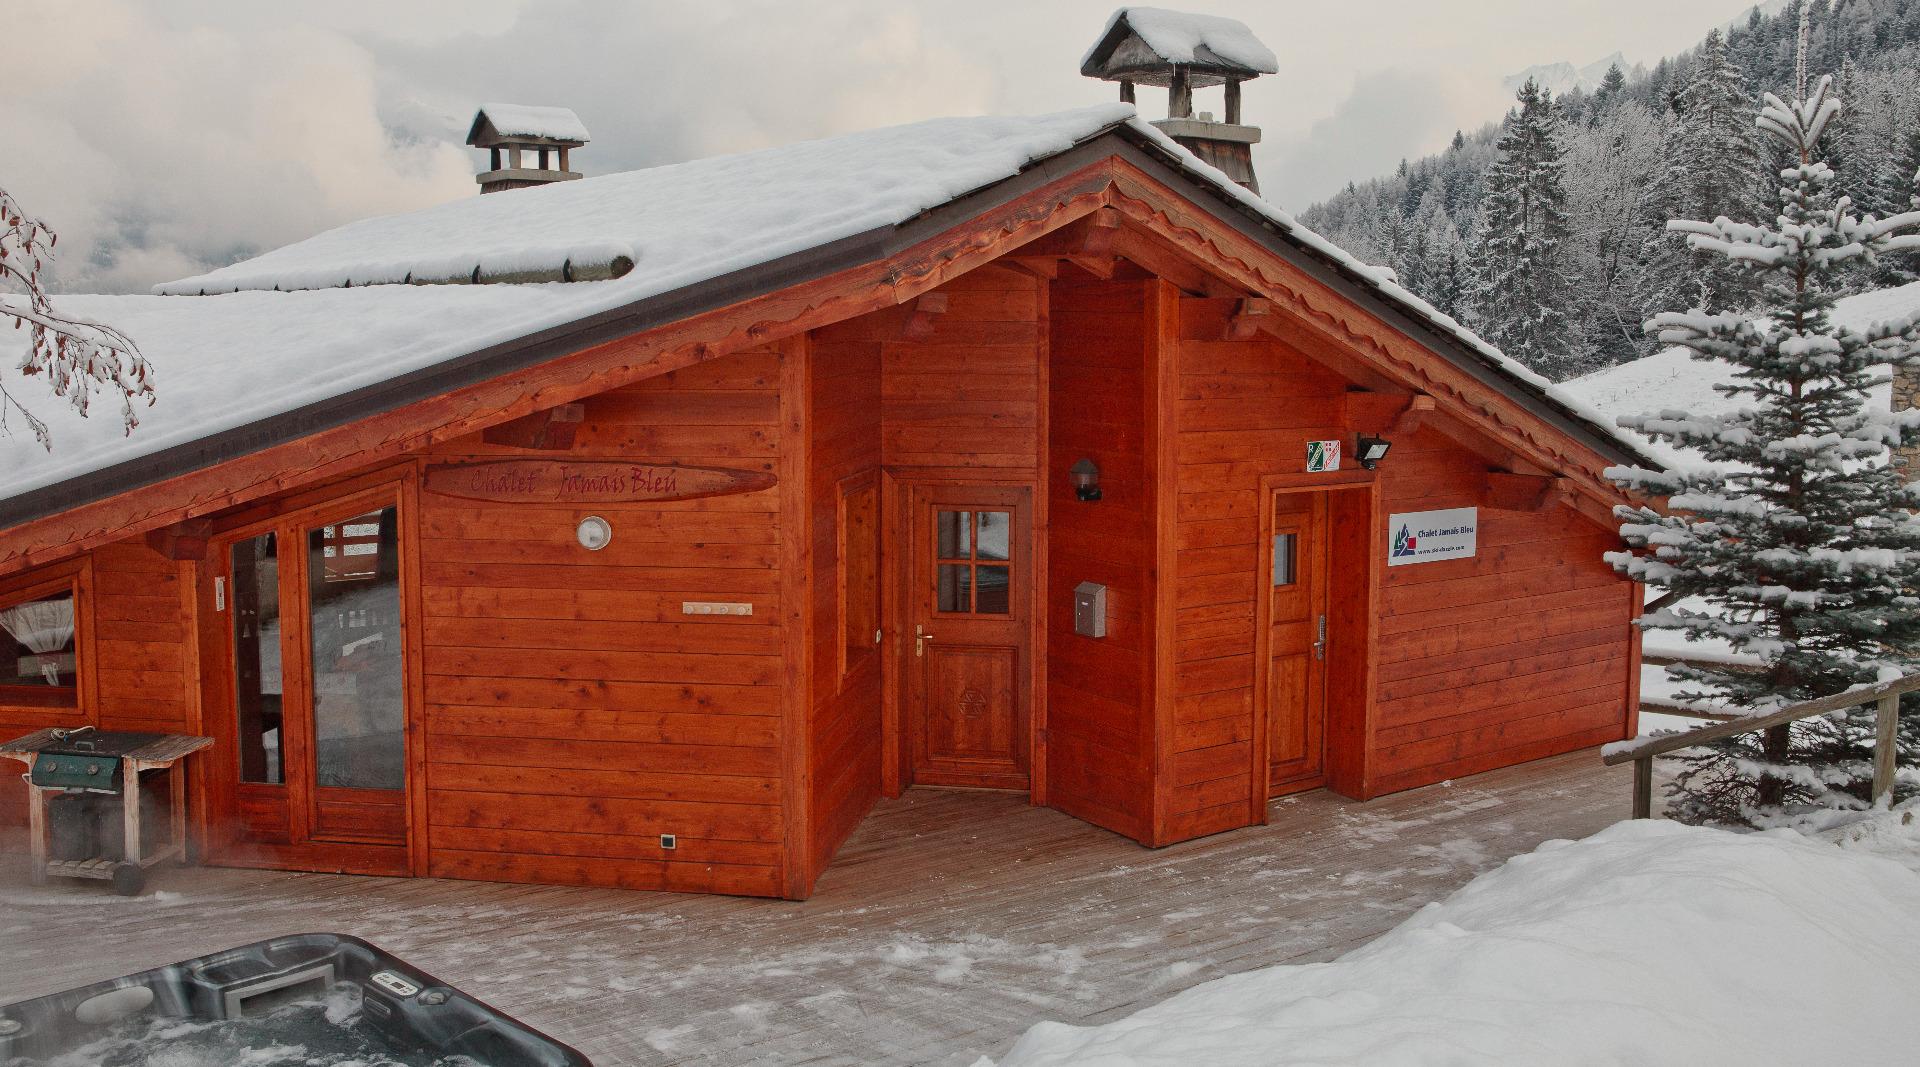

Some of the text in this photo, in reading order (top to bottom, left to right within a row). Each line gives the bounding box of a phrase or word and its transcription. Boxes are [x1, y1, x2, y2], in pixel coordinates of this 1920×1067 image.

[471, 466, 537, 493] Chalet
[554, 465, 625, 501] Jamais
[1418, 525, 1474, 538] Chalet Jamais Bleu
